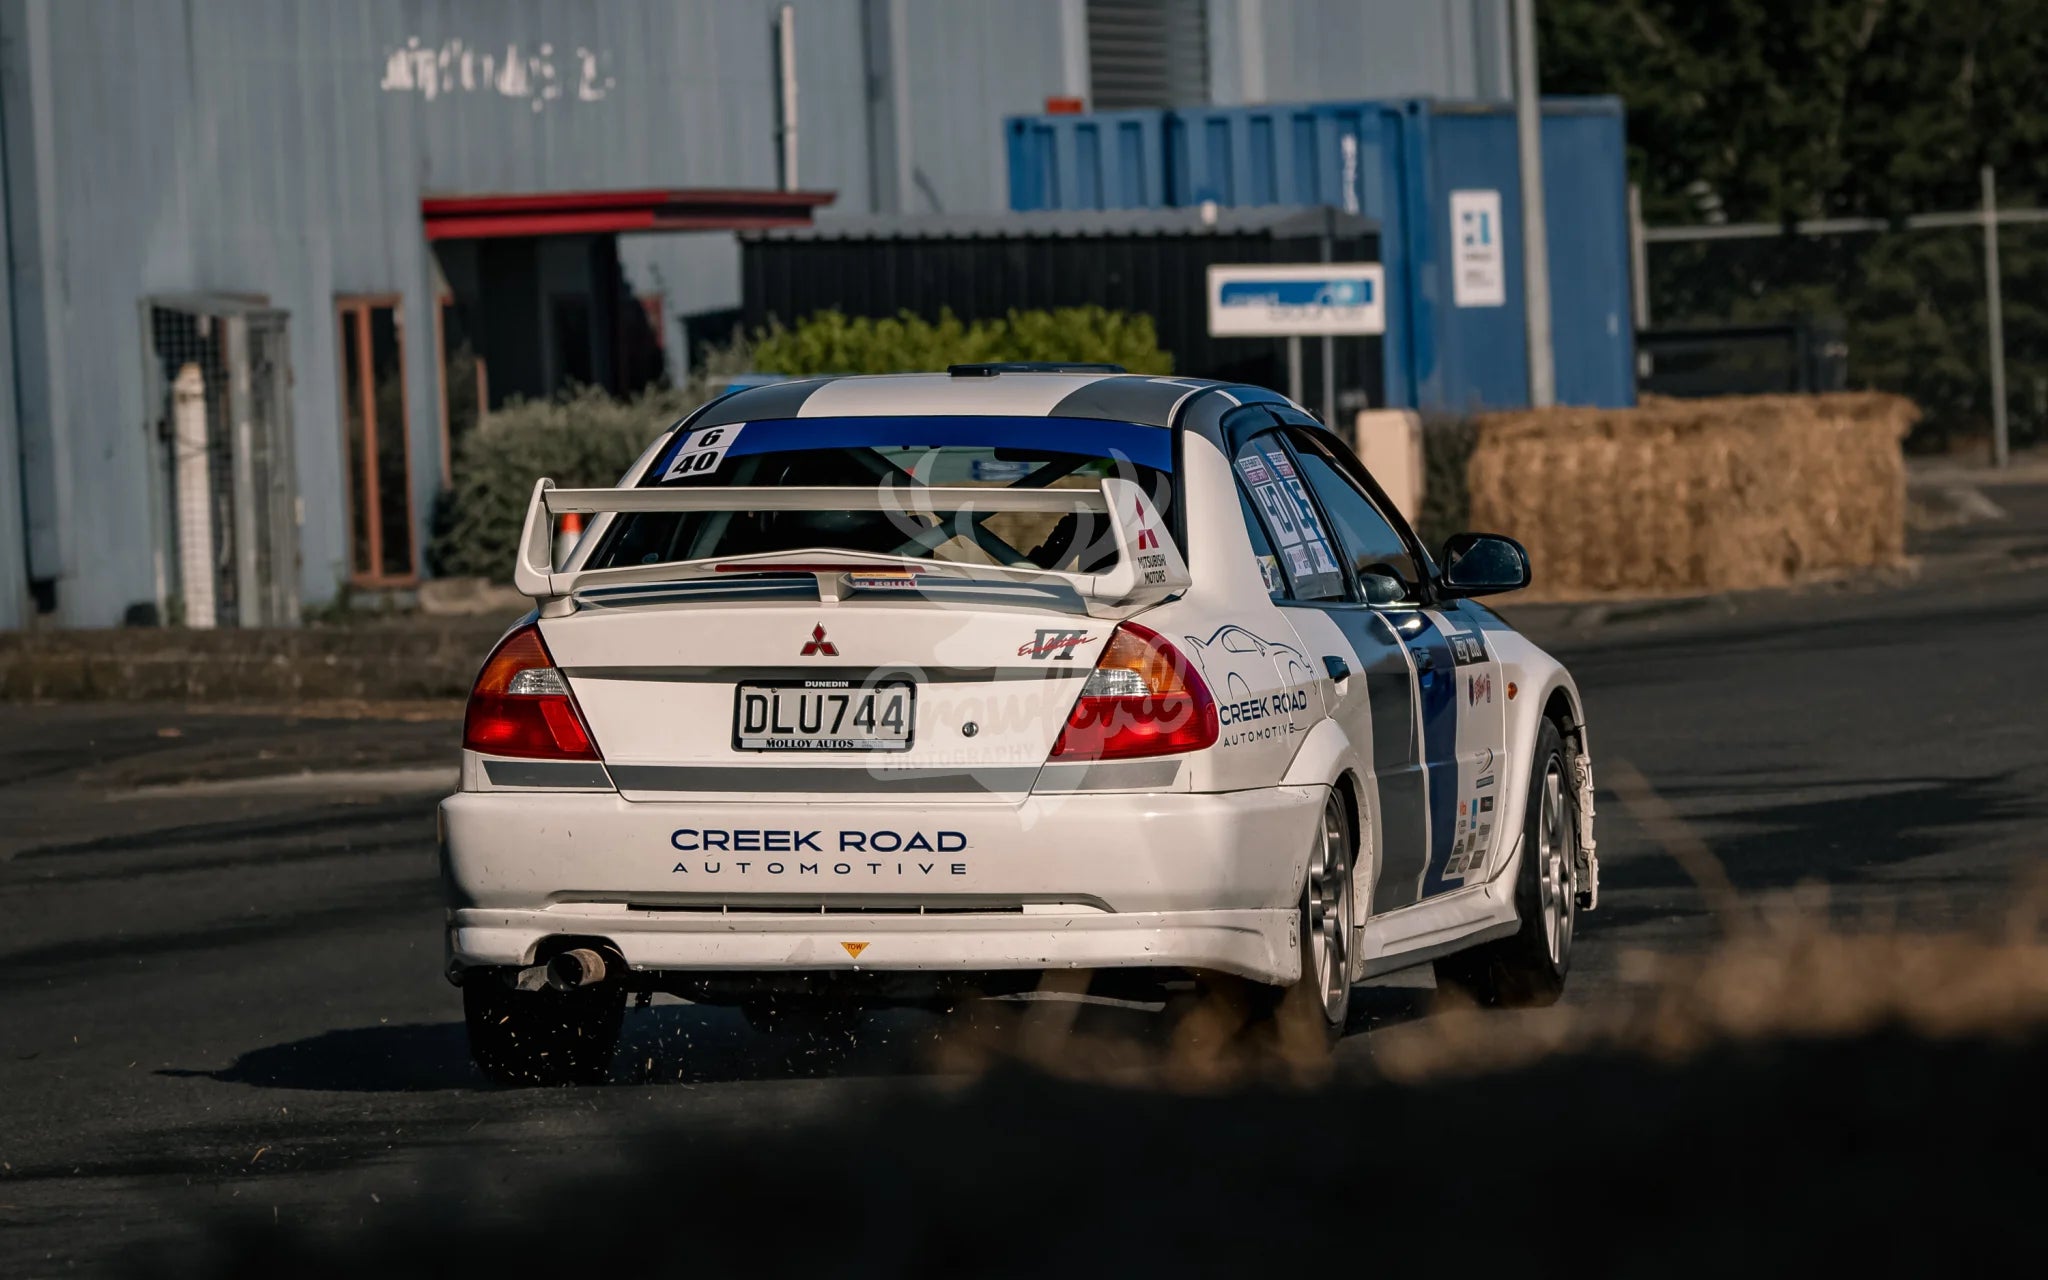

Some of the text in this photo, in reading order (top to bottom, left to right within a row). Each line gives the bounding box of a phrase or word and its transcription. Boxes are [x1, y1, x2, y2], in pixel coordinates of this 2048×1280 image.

[698, 428, 724, 447] 6
[672, 451, 719, 474] 40
[1137, 554, 1167, 569] MITSUBISHI
[1144, 570, 1167, 585] MOTORS
[744, 694, 904, 734] DLU744
[1220, 690, 1307, 726] CREEK ROAD
[766, 740, 811, 748] MOLLOY
[816, 740, 854, 748] AUTOS
[1224, 723, 1294, 748] AUTOMOTIVE
[670, 829, 967, 852] CREEK ROAD
[672, 862, 966, 875] AUTOMOTIVE
[847, 943, 863, 951] TOW
